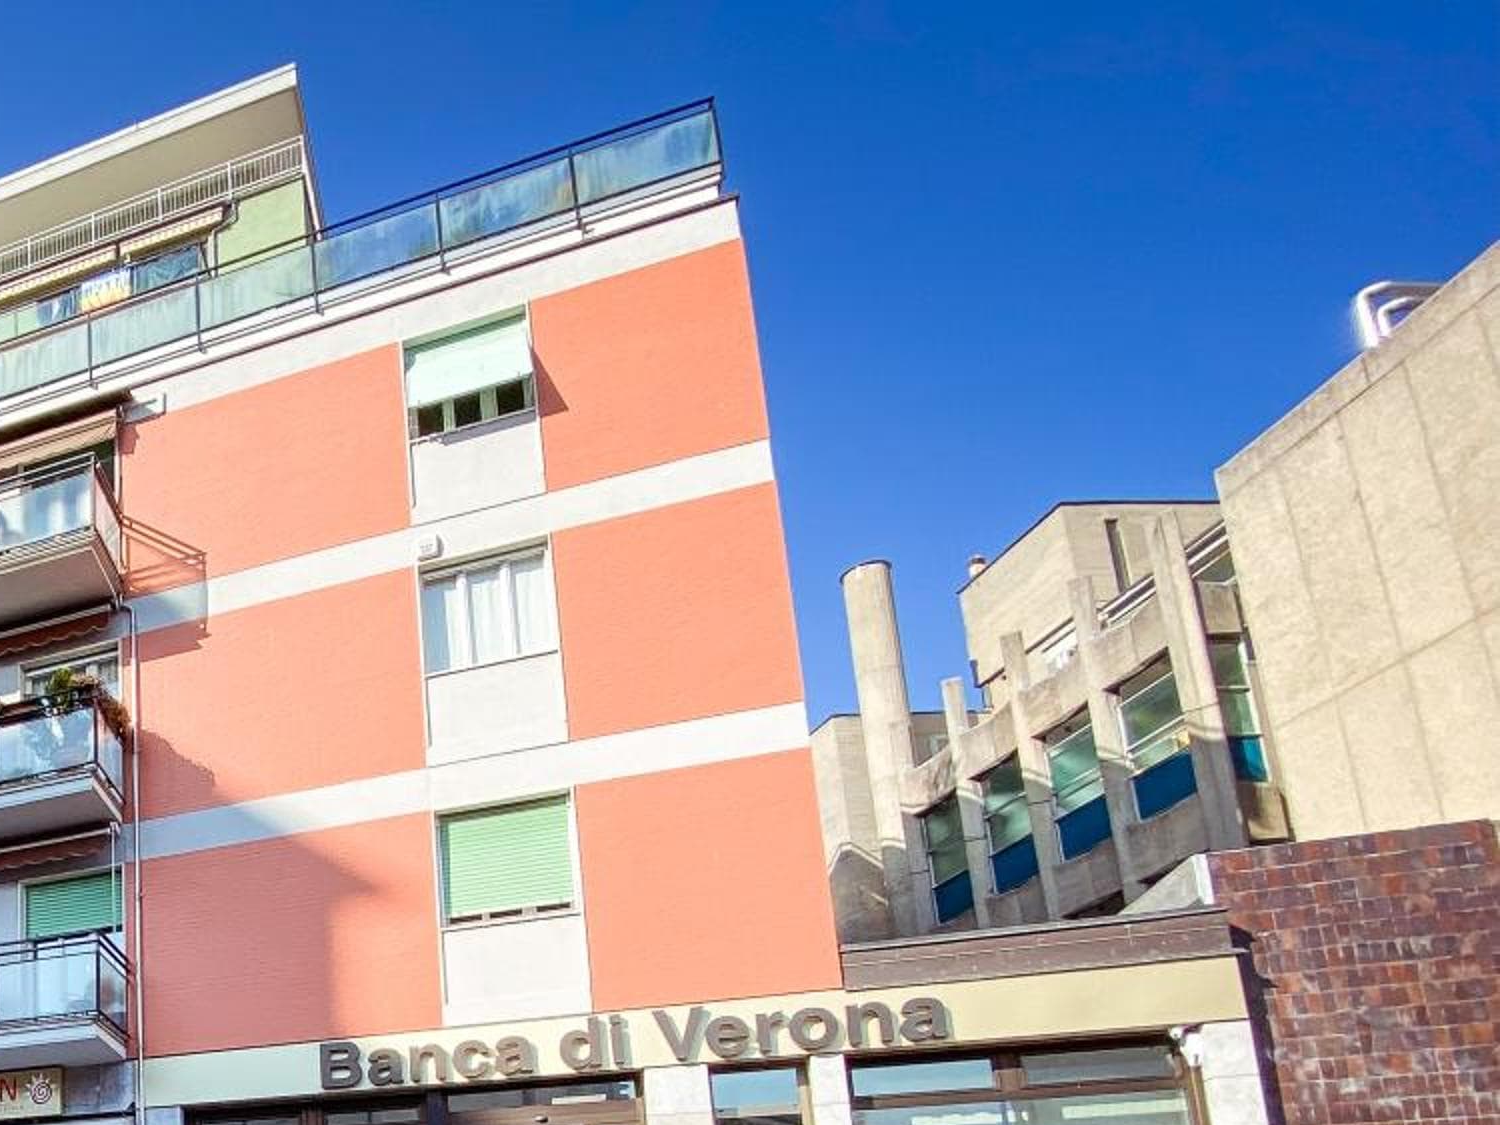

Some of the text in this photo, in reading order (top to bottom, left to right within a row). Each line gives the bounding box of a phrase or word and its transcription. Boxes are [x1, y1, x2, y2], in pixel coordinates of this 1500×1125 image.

[320, 996, 947, 1090] Banca di Verona
